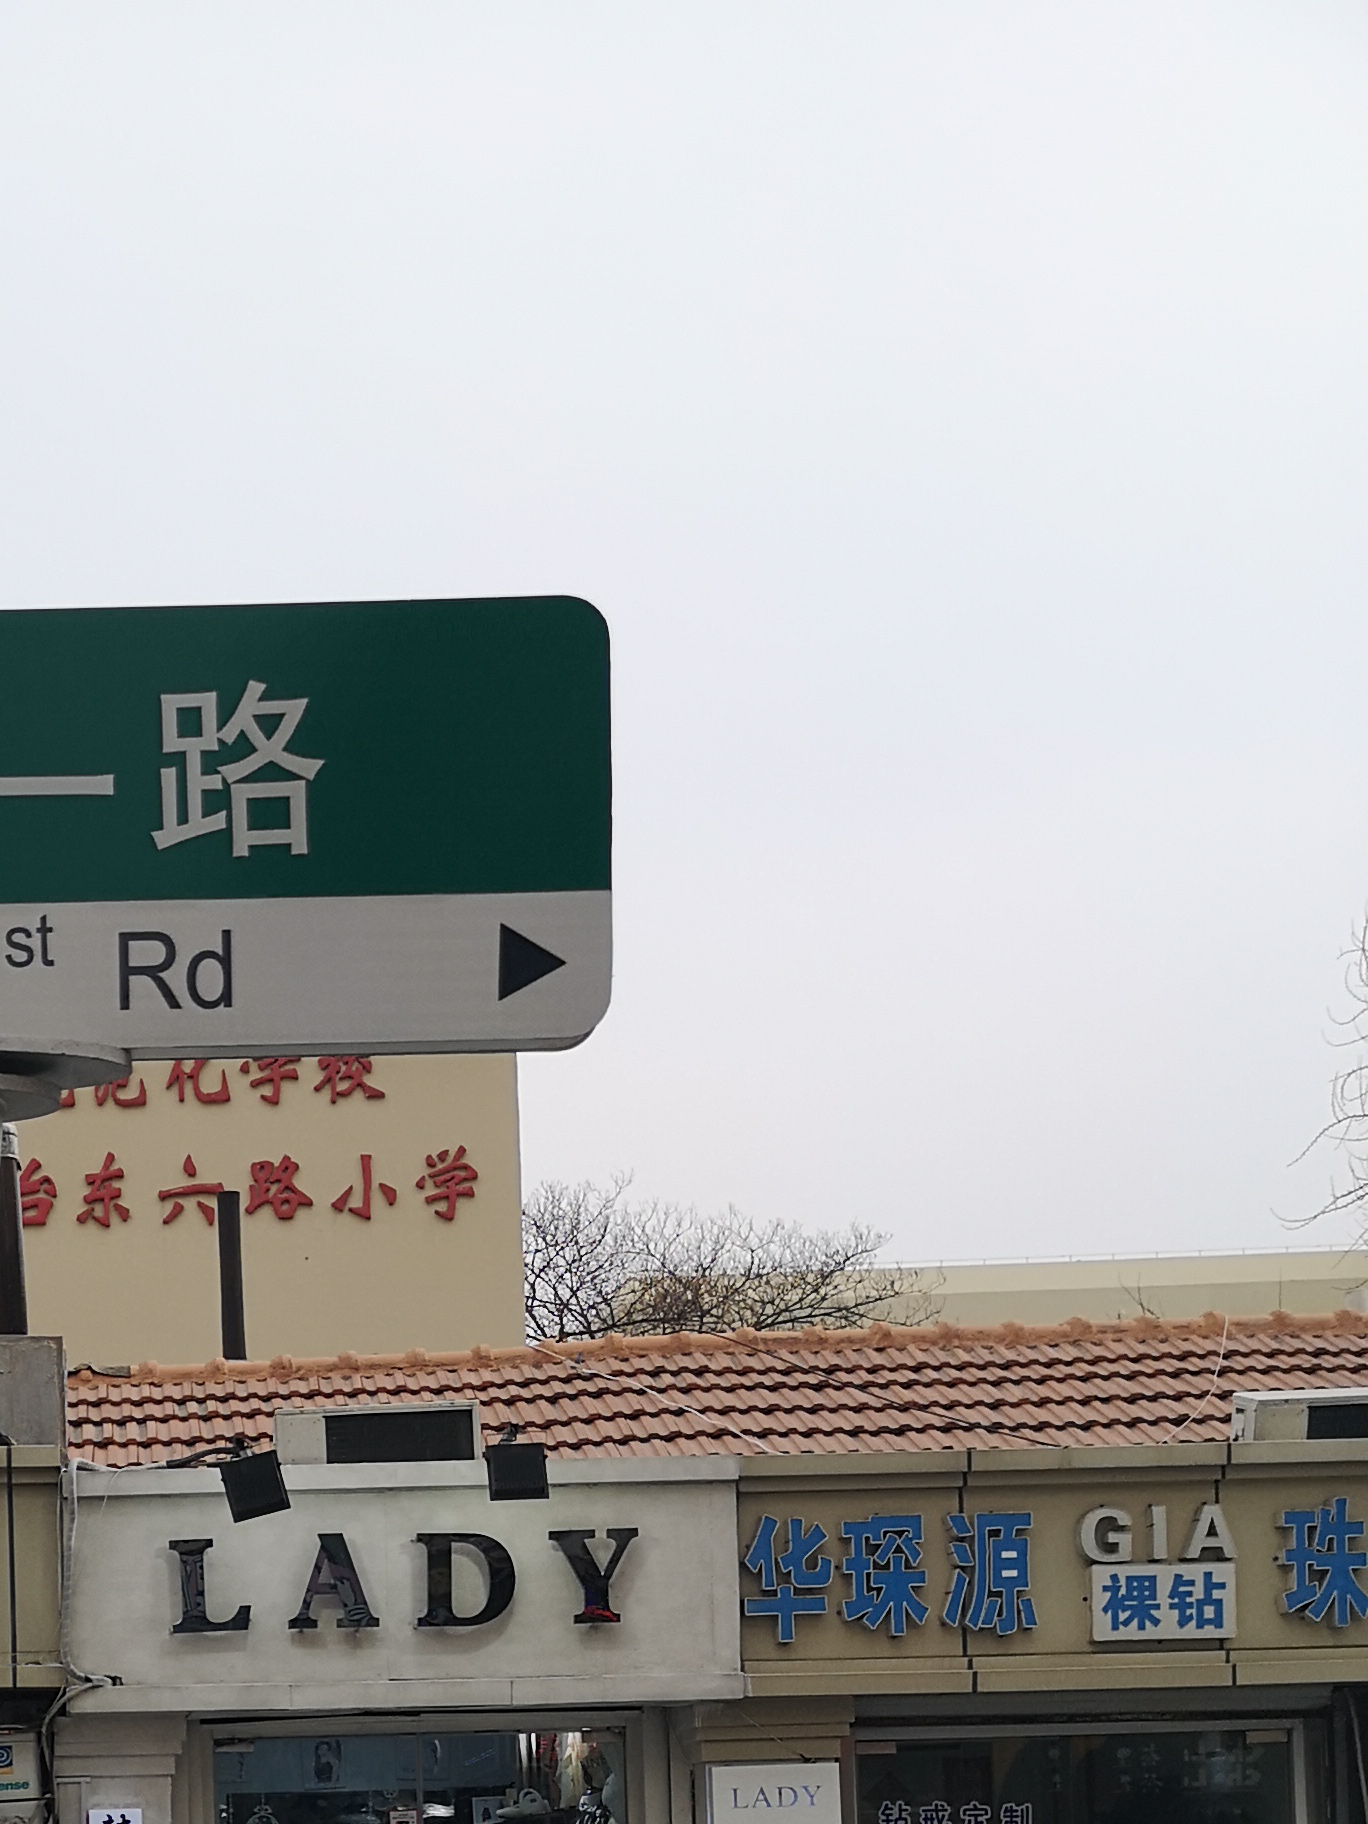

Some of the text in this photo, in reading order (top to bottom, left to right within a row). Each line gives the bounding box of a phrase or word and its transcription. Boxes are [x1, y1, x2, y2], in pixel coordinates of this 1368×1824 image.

[116, 926, 235, 1013] Rd
[745, 1511, 1038, 1643] 华琛源
[1079, 1504, 1238, 1564] GIA
[1279, 1497, 1368, 1628] 珠
[168, 1527, 640, 1633] LADY
[1100, 1572, 1227, 1632] 裸钻
[732, 1785, 822, 1809] LADY
